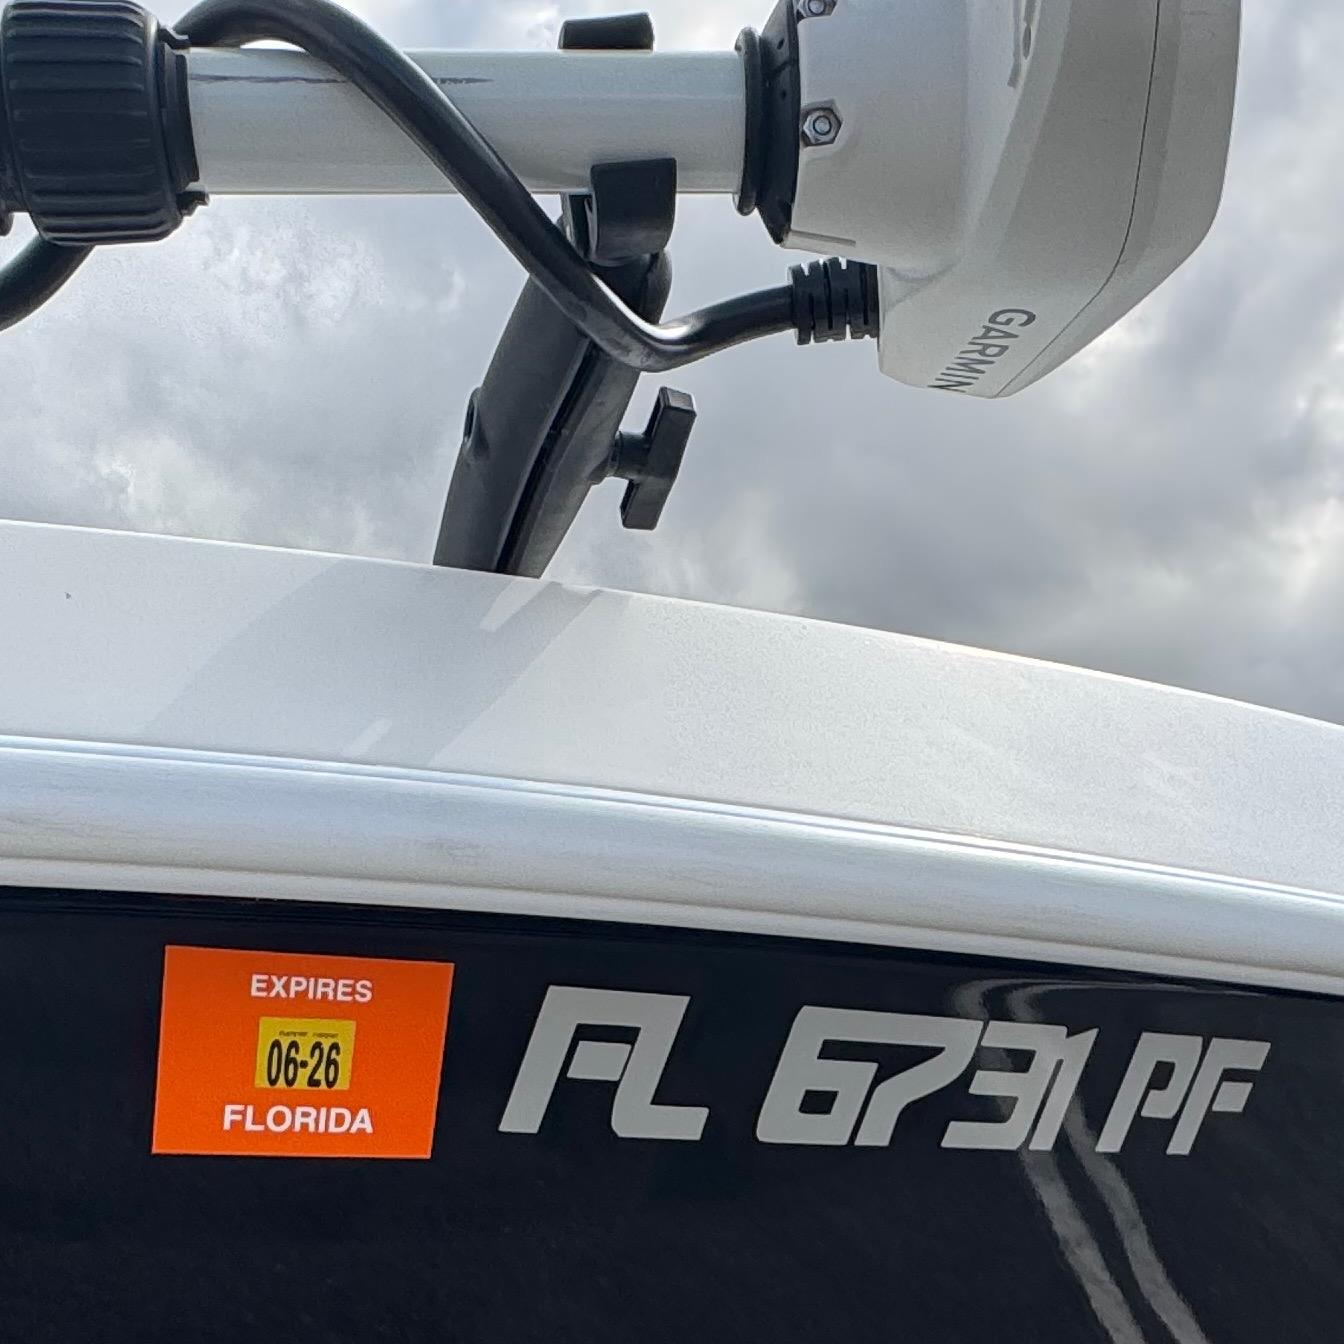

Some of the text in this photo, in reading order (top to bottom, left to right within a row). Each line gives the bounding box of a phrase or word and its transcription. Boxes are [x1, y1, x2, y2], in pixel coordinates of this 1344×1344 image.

[927, 307, 1036, 393] GARMIN
[250, 974, 373, 1003] EXPIRES
[266, 1039, 341, 1089] 06-26
[499, 985, 1271, 1155] FL 6731 PF
[223, 1104, 373, 1135] FLORIDA
